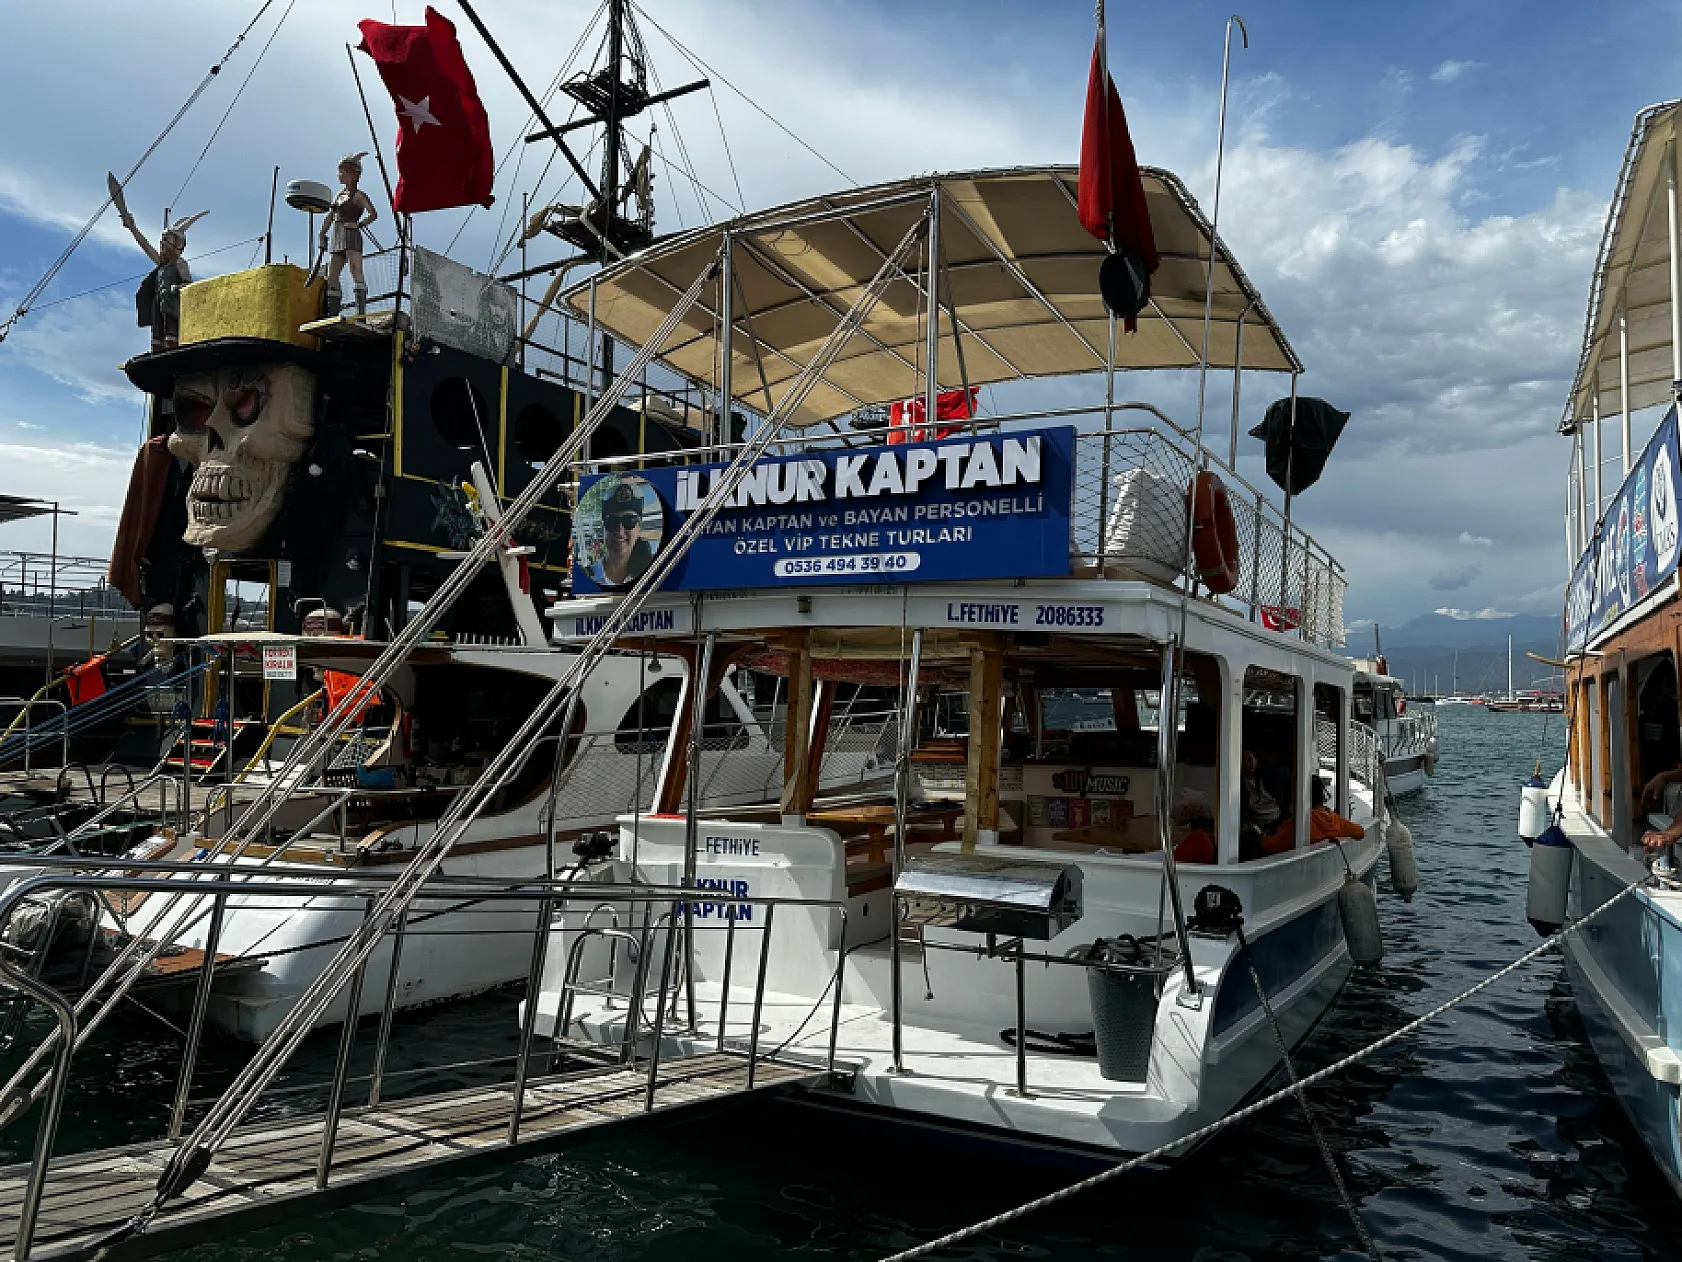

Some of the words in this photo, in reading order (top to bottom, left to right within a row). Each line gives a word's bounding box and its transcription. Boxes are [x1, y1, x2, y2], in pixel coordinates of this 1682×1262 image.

[835, 435, 1042, 498] KAPTAN
[742, 512, 812, 535] KAPTAN
[818, 514, 838, 527] ve
[844, 505, 908, 526] BAYAN
[914, 491, 1043, 520] PERSONELLİ
[733, 537, 778, 555] ÖZEL
[784, 533, 813, 551] VİP
[819, 530, 880, 549] TEKNE
[886, 526, 973, 546] TURLARI
[784, 558, 822, 575] 0536
[826, 557, 856, 572] 494
[860, 556, 880, 570] 39
[884, 554, 907, 569] 40
[1035, 604, 1105, 627] 2086333
